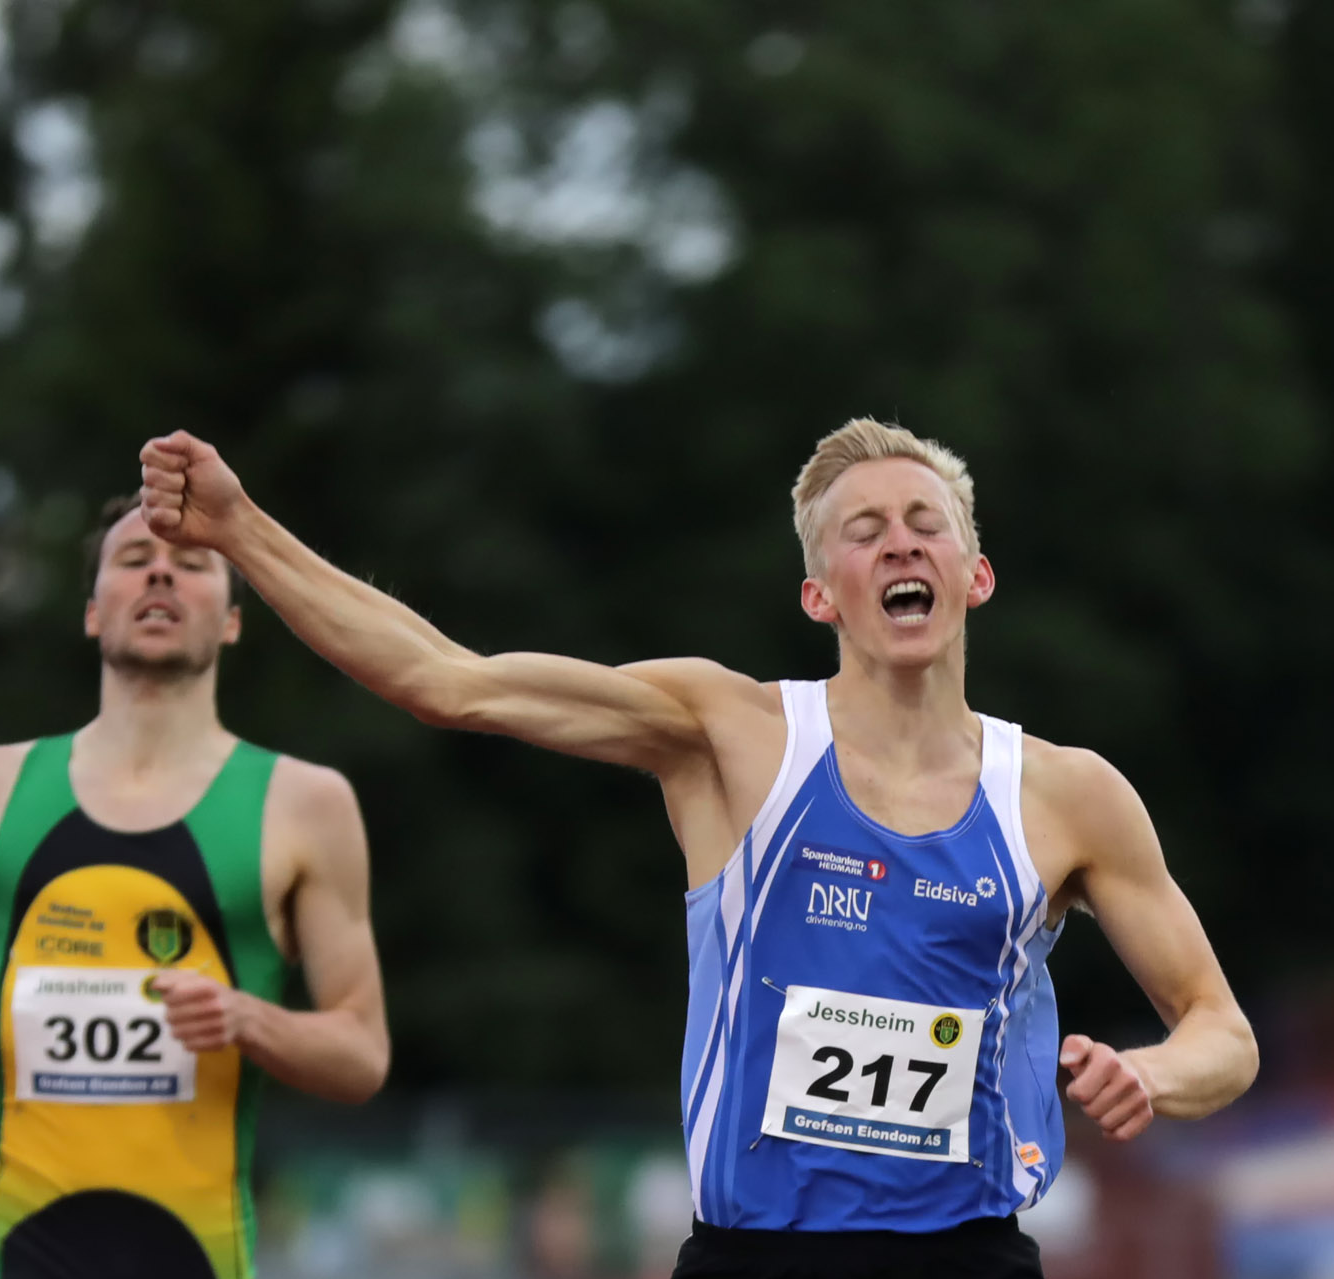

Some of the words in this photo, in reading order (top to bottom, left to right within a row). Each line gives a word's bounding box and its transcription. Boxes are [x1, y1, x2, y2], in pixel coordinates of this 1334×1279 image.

[802, 847, 864, 869] Sparebanken
[818, 861, 863, 876] HEDMARK
[913, 878, 978, 907] Eidsiva
[805, 914, 868, 932] drivtrening.no
[35, 978, 127, 995] Jessheim
[807, 1001, 915, 1034] Jessheim
[44, 1015, 162, 1063] 302
[806, 1046, 948, 1113] 217
[794, 1114, 853, 1136] Grefsen
[857, 1125, 921, 1146] Eiendom
[923, 1134, 942, 1147] AS
